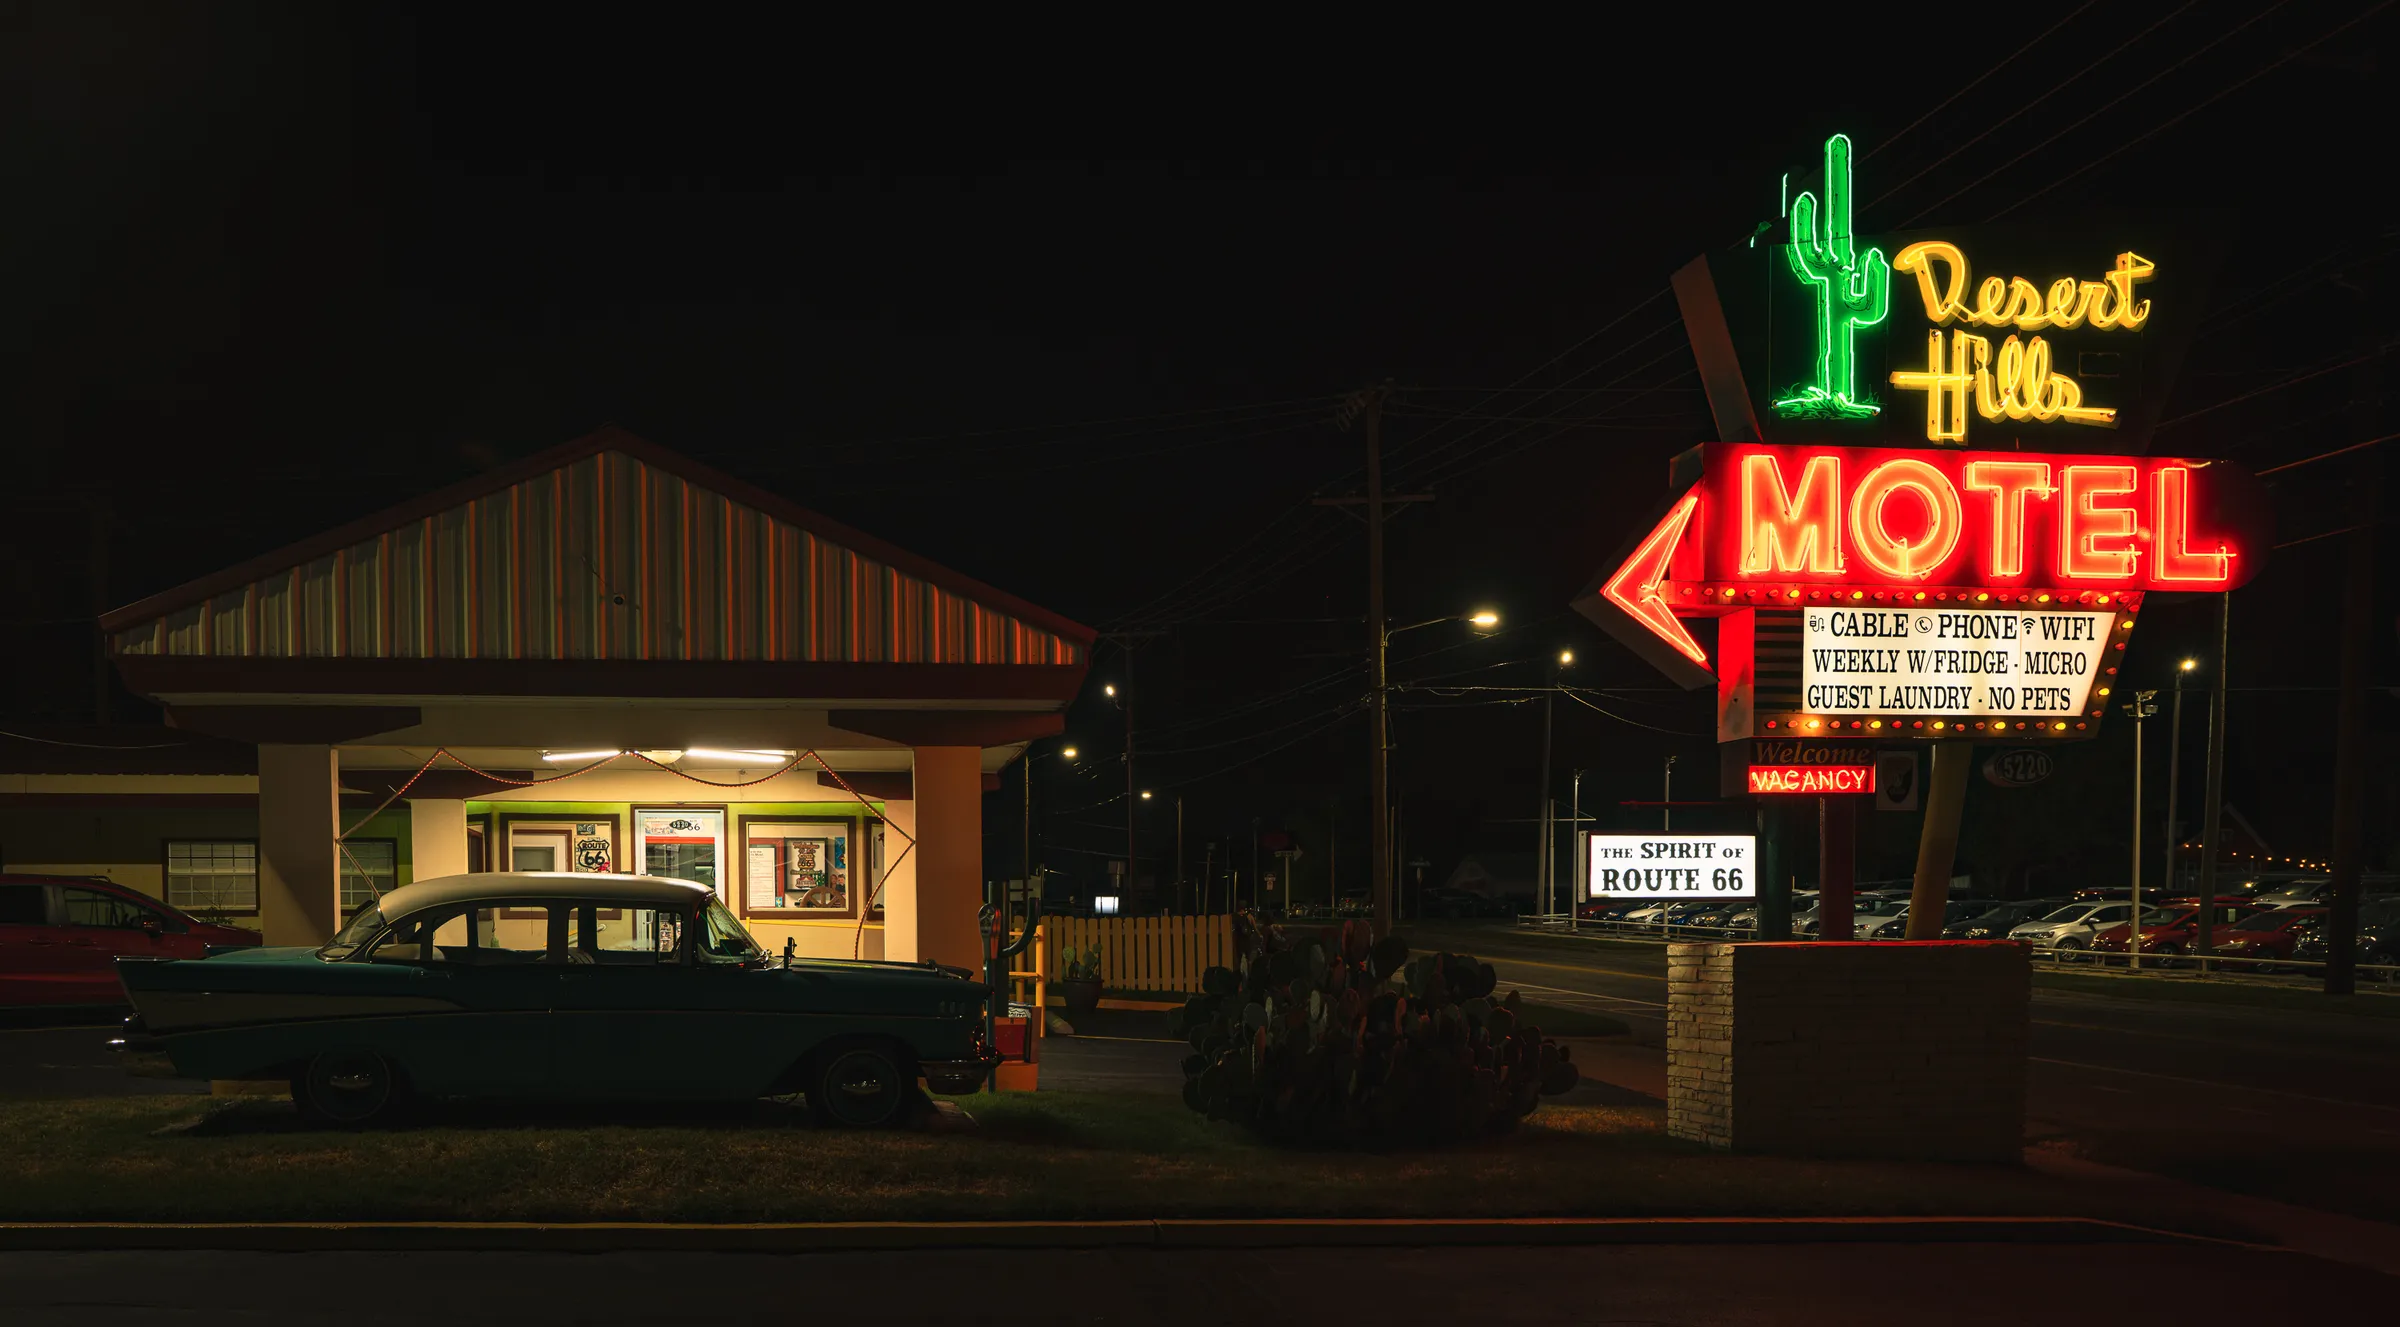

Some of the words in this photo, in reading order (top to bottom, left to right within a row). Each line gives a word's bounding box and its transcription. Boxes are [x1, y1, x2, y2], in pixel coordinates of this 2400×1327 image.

[1893, 240, 2156, 331] Desert
[1889, 328, 2119, 444] Hills
[1740, 453, 2236, 582] MOTEL
[1831, 611, 1909, 637] CABLE
[1938, 614, 2018, 639] PHONE
[2040, 616, 2095, 641] WIFI
[1813, 648, 1900, 673] WEEKLY
[1908, 649, 2008, 675] W/FRIDGE
[2024, 652, 2087, 675] MICRO
[1808, 685, 1873, 709] GUEST
[1879, 686, 1972, 710] LAUNDRY
[1989, 686, 2015, 710] NO
[2021, 687, 2071, 711] PETS
[1755, 741, 1871, 765] Welcome
[2003, 756, 2048, 779] 5220
[1752, 769, 1866, 792] VACANCY
[584, 850, 606, 866] 66
[1601, 848, 1633, 858] THE
[1640, 842, 1716, 859] SPIRIT
[1722, 848, 1744, 858] OF
[1601, 868, 1701, 891] ROUTE
[1712, 868, 1743, 891] 66
